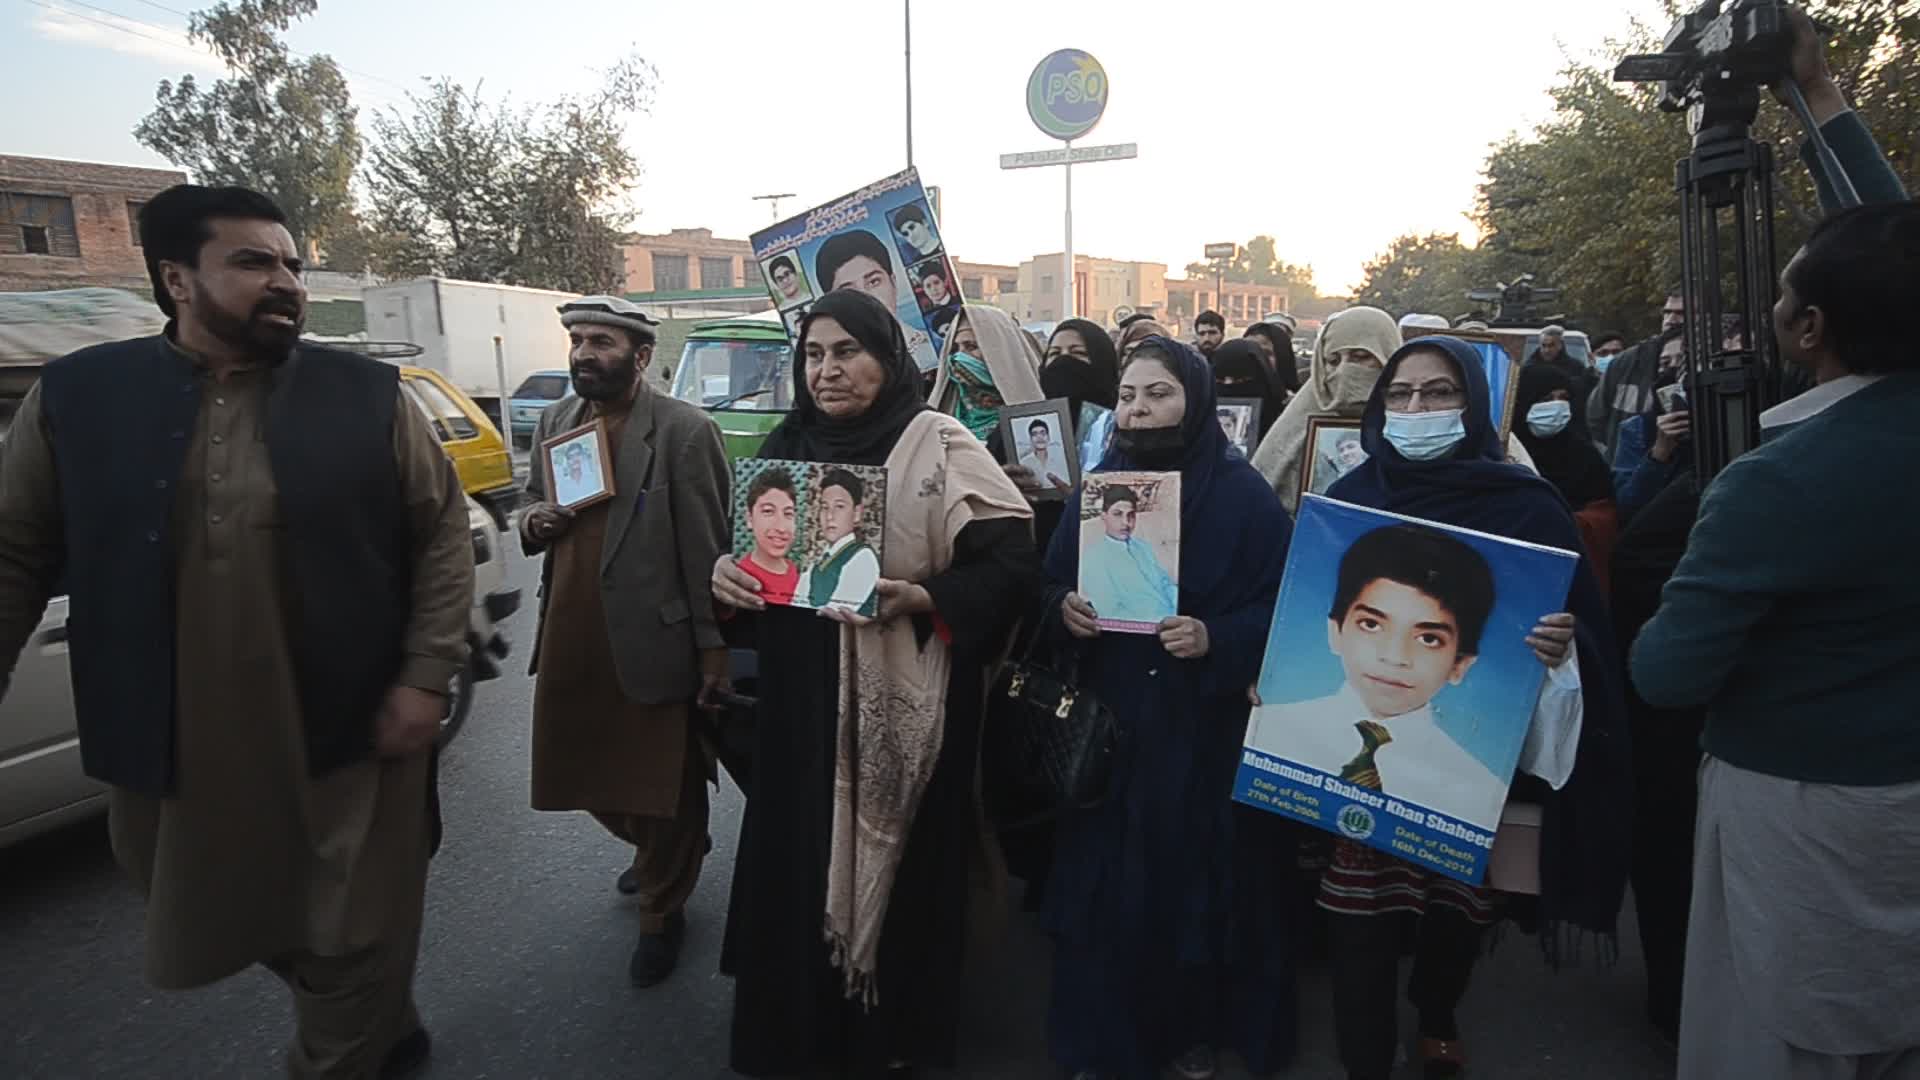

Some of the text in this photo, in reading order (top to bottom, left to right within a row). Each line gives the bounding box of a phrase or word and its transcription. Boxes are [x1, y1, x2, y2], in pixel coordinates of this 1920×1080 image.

[1047, 70, 1104, 105] PSO
[1243, 751, 1324, 788] Muhammad
[1324, 777, 1385, 808] Shaheer
[1385, 798, 1425, 824] Khan
[1248, 788, 1270, 803] 27th
[1253, 777, 1320, 807] Date of Birth
[1391, 839, 1473, 876] 16th Dec-2014
[1395, 826, 1476, 863] Date of Death
